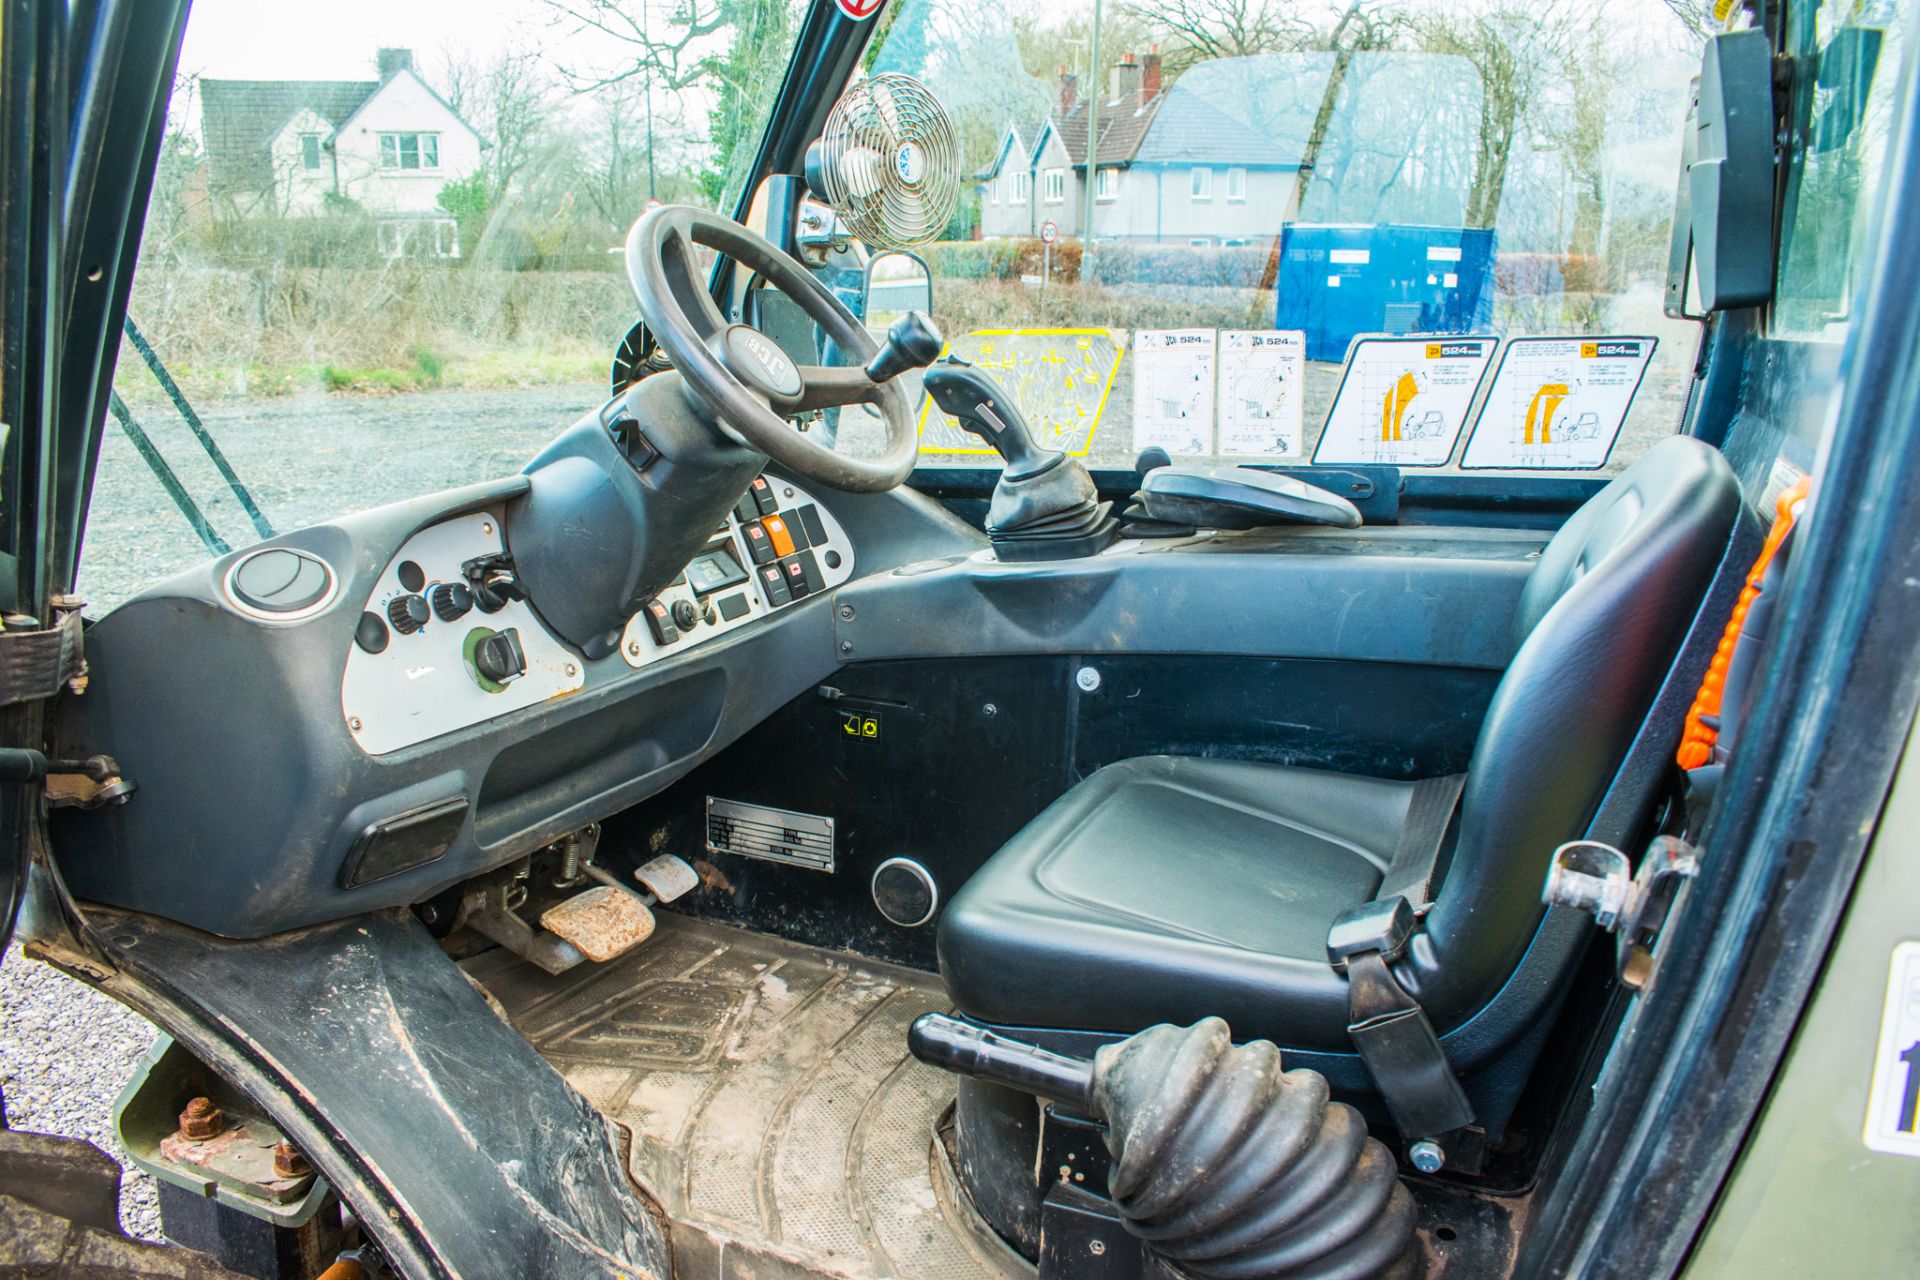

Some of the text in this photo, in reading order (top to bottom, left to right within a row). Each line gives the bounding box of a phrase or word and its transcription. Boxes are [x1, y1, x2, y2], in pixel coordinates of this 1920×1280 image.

[1180, 336, 1202, 344] 524
[1266, 337, 1289, 346] 524
[747, 338, 786, 376] JCB
